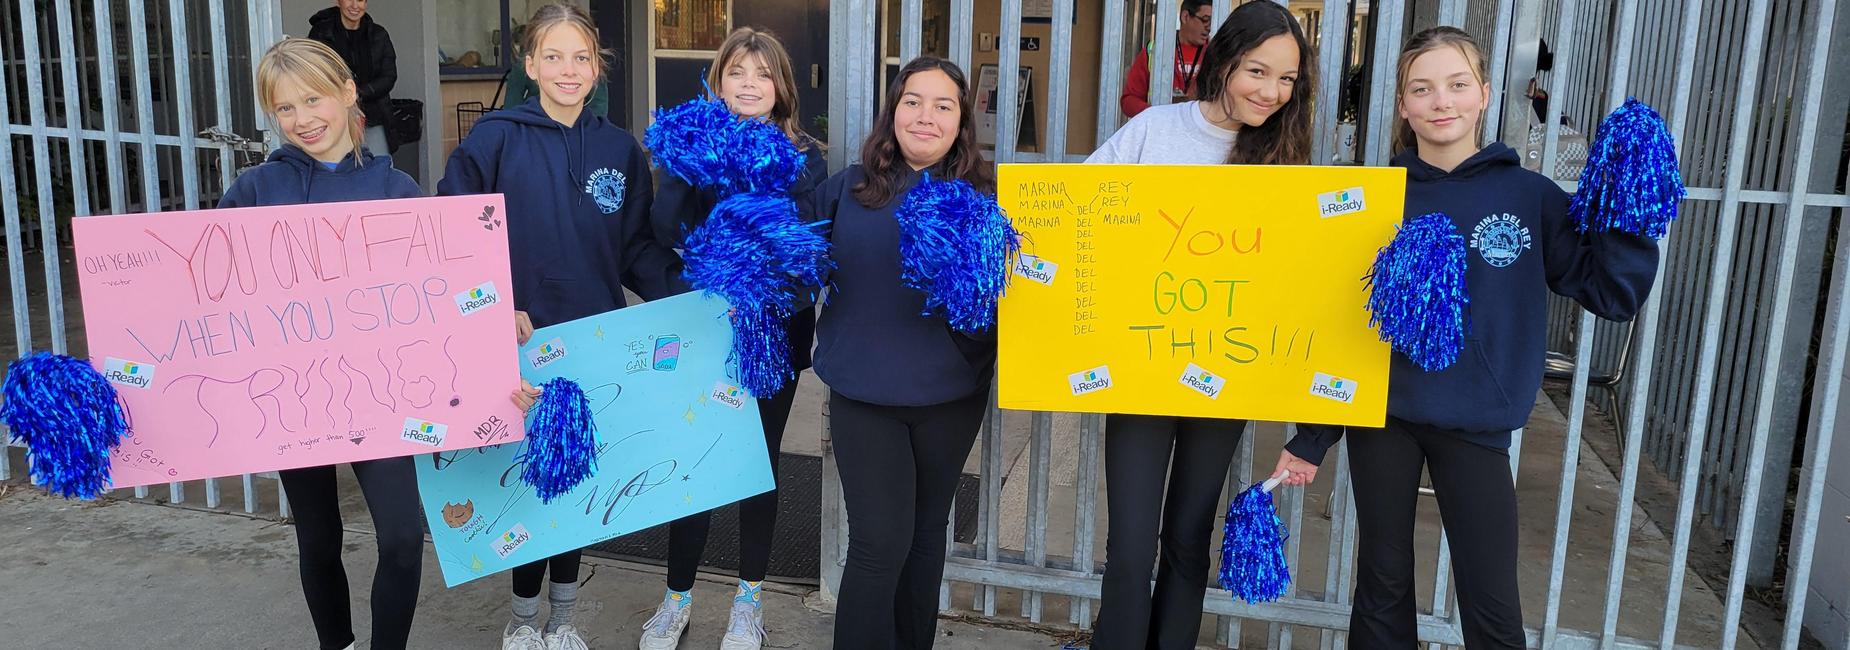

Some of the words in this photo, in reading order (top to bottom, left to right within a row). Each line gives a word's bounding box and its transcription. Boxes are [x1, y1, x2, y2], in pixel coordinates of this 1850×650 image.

[586, 168, 609, 194] MARINA
[612, 169, 626, 184] DEL
[1019, 182, 1066, 196] MARINA
[1099, 181, 1132, 193] REY
[1019, 199, 1064, 211] MARINA
[1077, 204, 1094, 215] DEL
[1102, 196, 1129, 208] REY
[1321, 199, 1362, 215] i-Ready
[1018, 215, 1060, 228] MARINA
[1076, 218, 1093, 227] DEL
[1103, 212, 1141, 225] MARINA
[1076, 229, 1093, 238] DEL
[1470, 214, 1499, 248] MARINA
[1502, 213, 1520, 227] DEL
[1520, 227, 1532, 249] REY
[1076, 241, 1095, 250] DEL
[84, 255, 107, 274] OH
[144, 222, 257, 304] YOU
[270, 214, 352, 289] ONLY
[361, 211, 473, 271] FAIL
[1076, 253, 1096, 263] DEL
[1075, 267, 1096, 278] DEL
[1076, 281, 1096, 292] DEL
[1154, 271, 1250, 317] GOT
[460, 293, 496, 313] i-Ready
[1076, 296, 1096, 308] DEL
[125, 310, 255, 363] WHEN
[266, 297, 334, 344] YOU
[346, 278, 447, 331] STOP
[1076, 310, 1097, 321] DEL
[1074, 323, 1095, 335] DEL
[624, 340, 644, 352] YES
[1129, 324, 1314, 371] THIS!!!
[532, 347, 565, 367] i-Ready
[105, 369, 149, 388] i-Ready
[1073, 378, 1109, 394] i-Ready
[1182, 372, 1217, 396] i-Ready
[163, 335, 460, 448] TRYING!
[713, 390, 743, 409] i-Ready
[1312, 382, 1351, 401] i-Ready
[473, 415, 501, 440] MDR
[404, 428, 442, 446] i-Ready
[277, 443, 292, 455] get
[299, 438, 320, 450] higher
[499, 532, 529, 556] i-Ready
